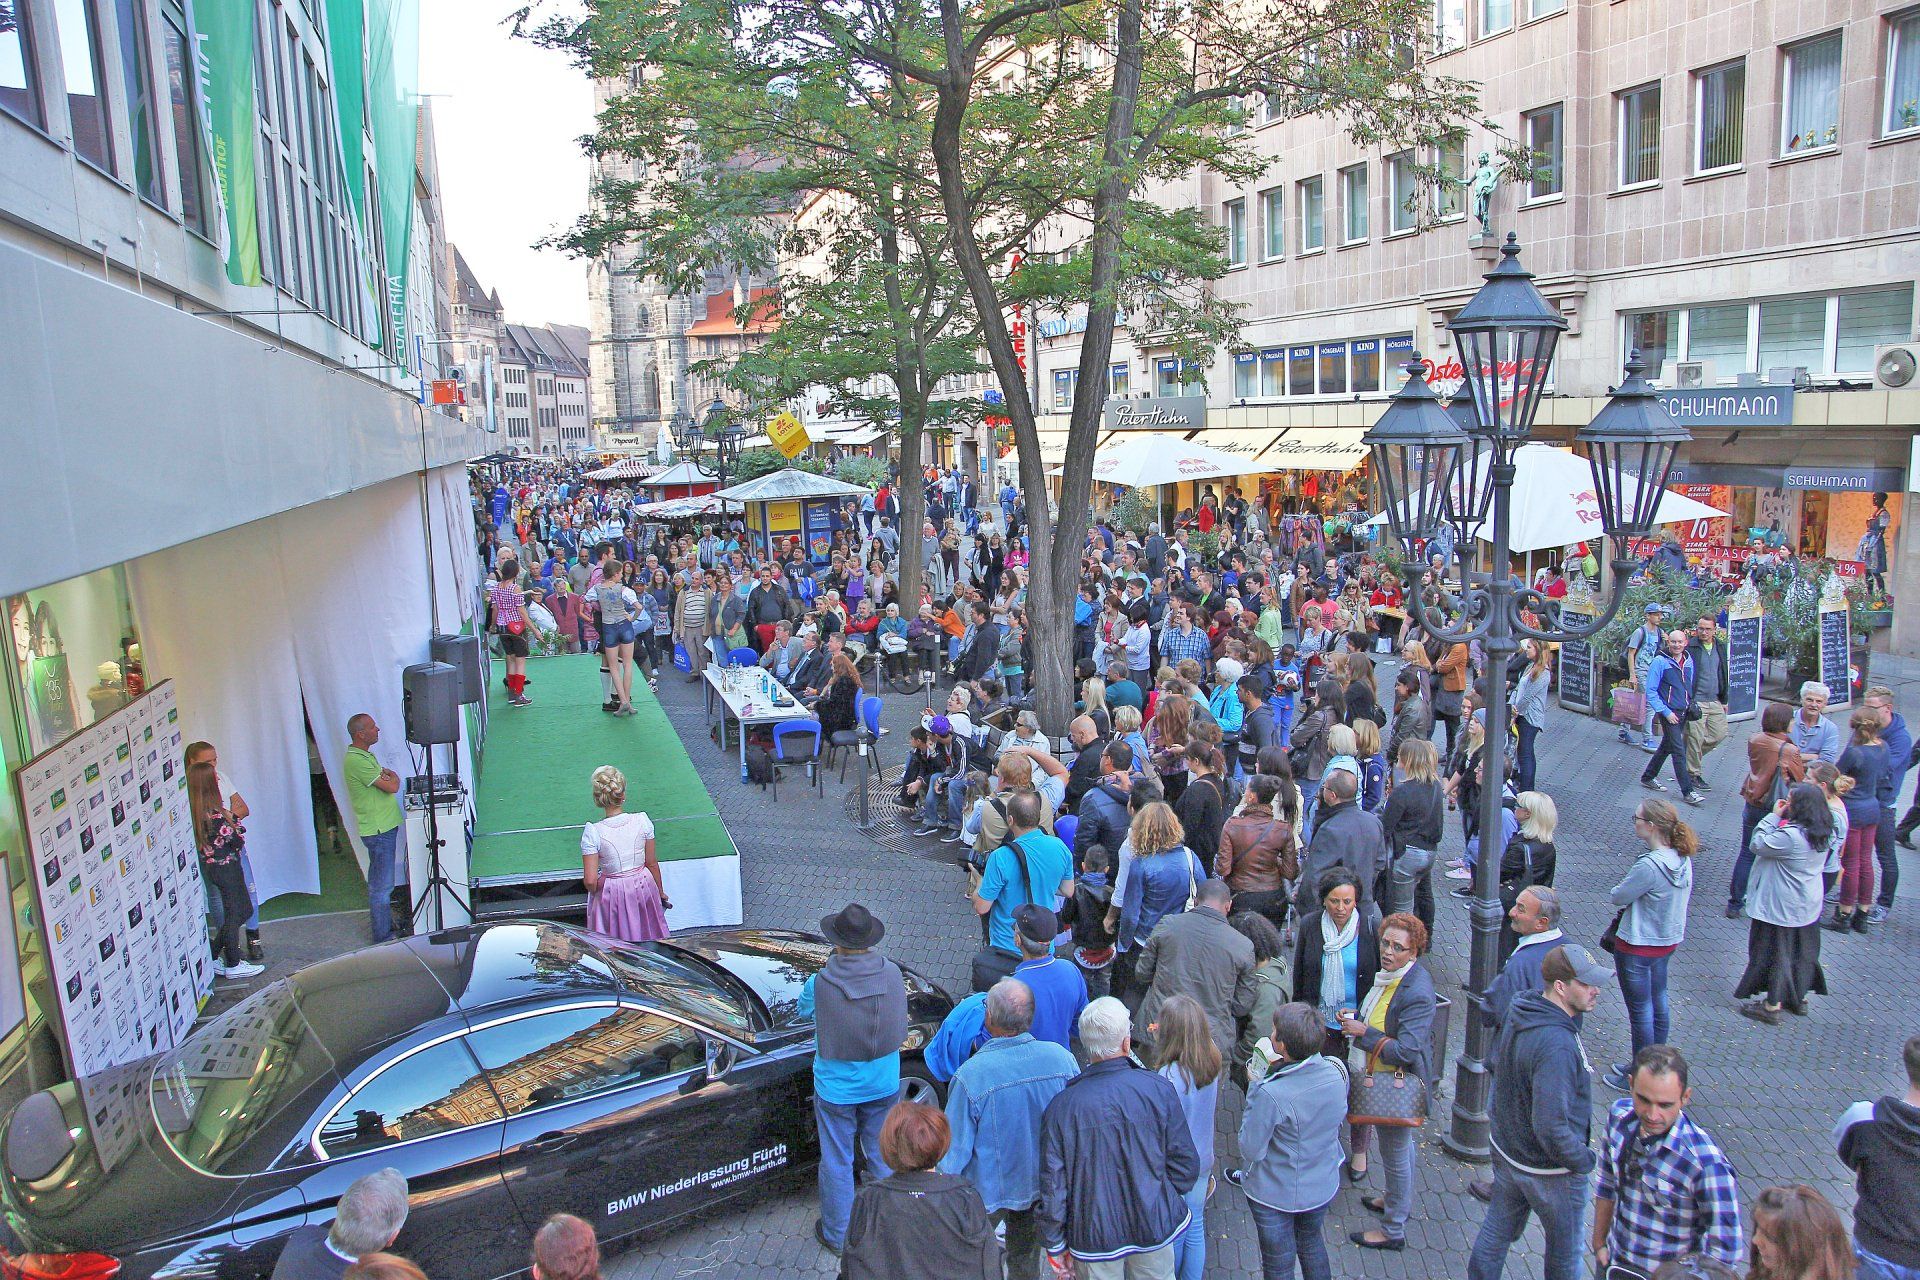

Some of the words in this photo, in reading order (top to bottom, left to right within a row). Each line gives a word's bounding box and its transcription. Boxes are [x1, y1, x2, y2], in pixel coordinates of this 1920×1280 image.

[389, 275, 406, 350] GALERIA
[1294, 348, 1311, 358] KIND
[1357, 342, 1374, 352] KIND
[1114, 404, 1150, 426] Peter
[1148, 404, 1190, 425] Hahn
[777, 421, 795, 438] LOTTO
[611, 435, 640, 446] Popcorn
[1313, 441, 1364, 455] Hahn
[1787, 475, 1868, 488] SCHUHMANN
[607, 1190, 648, 1216] BMW
[650, 1156, 749, 1201] Niederlassung
[751, 1142, 788, 1165] Fürth
[710, 1155, 788, 1190] www.bmw-fuerth.de
